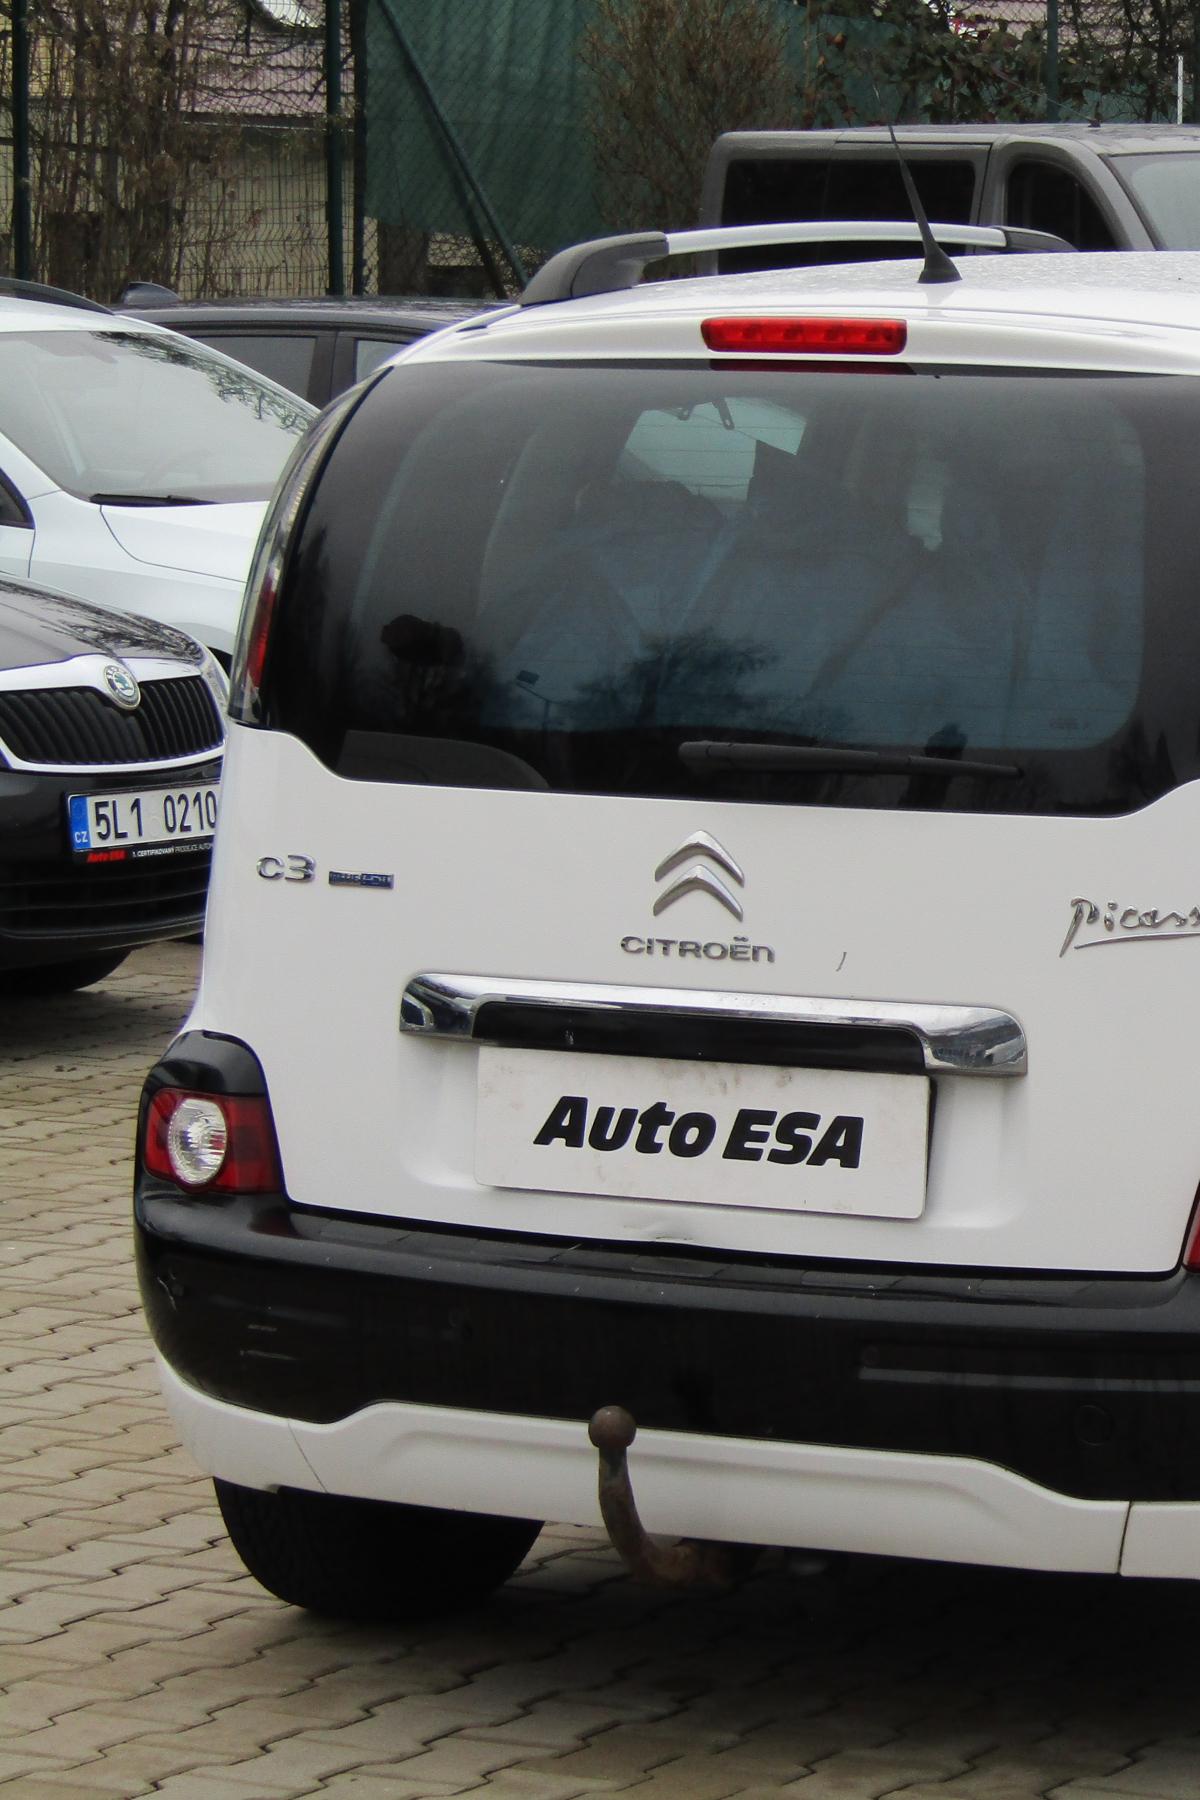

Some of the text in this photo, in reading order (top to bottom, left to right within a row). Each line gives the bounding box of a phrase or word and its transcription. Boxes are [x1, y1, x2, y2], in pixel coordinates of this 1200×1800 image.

[94, 790, 217, 841] 5L1 0210
[74, 830, 88, 844] CZ
[256, 854, 316, 883] C3
[533, 1095, 865, 1169] Auto ESA
